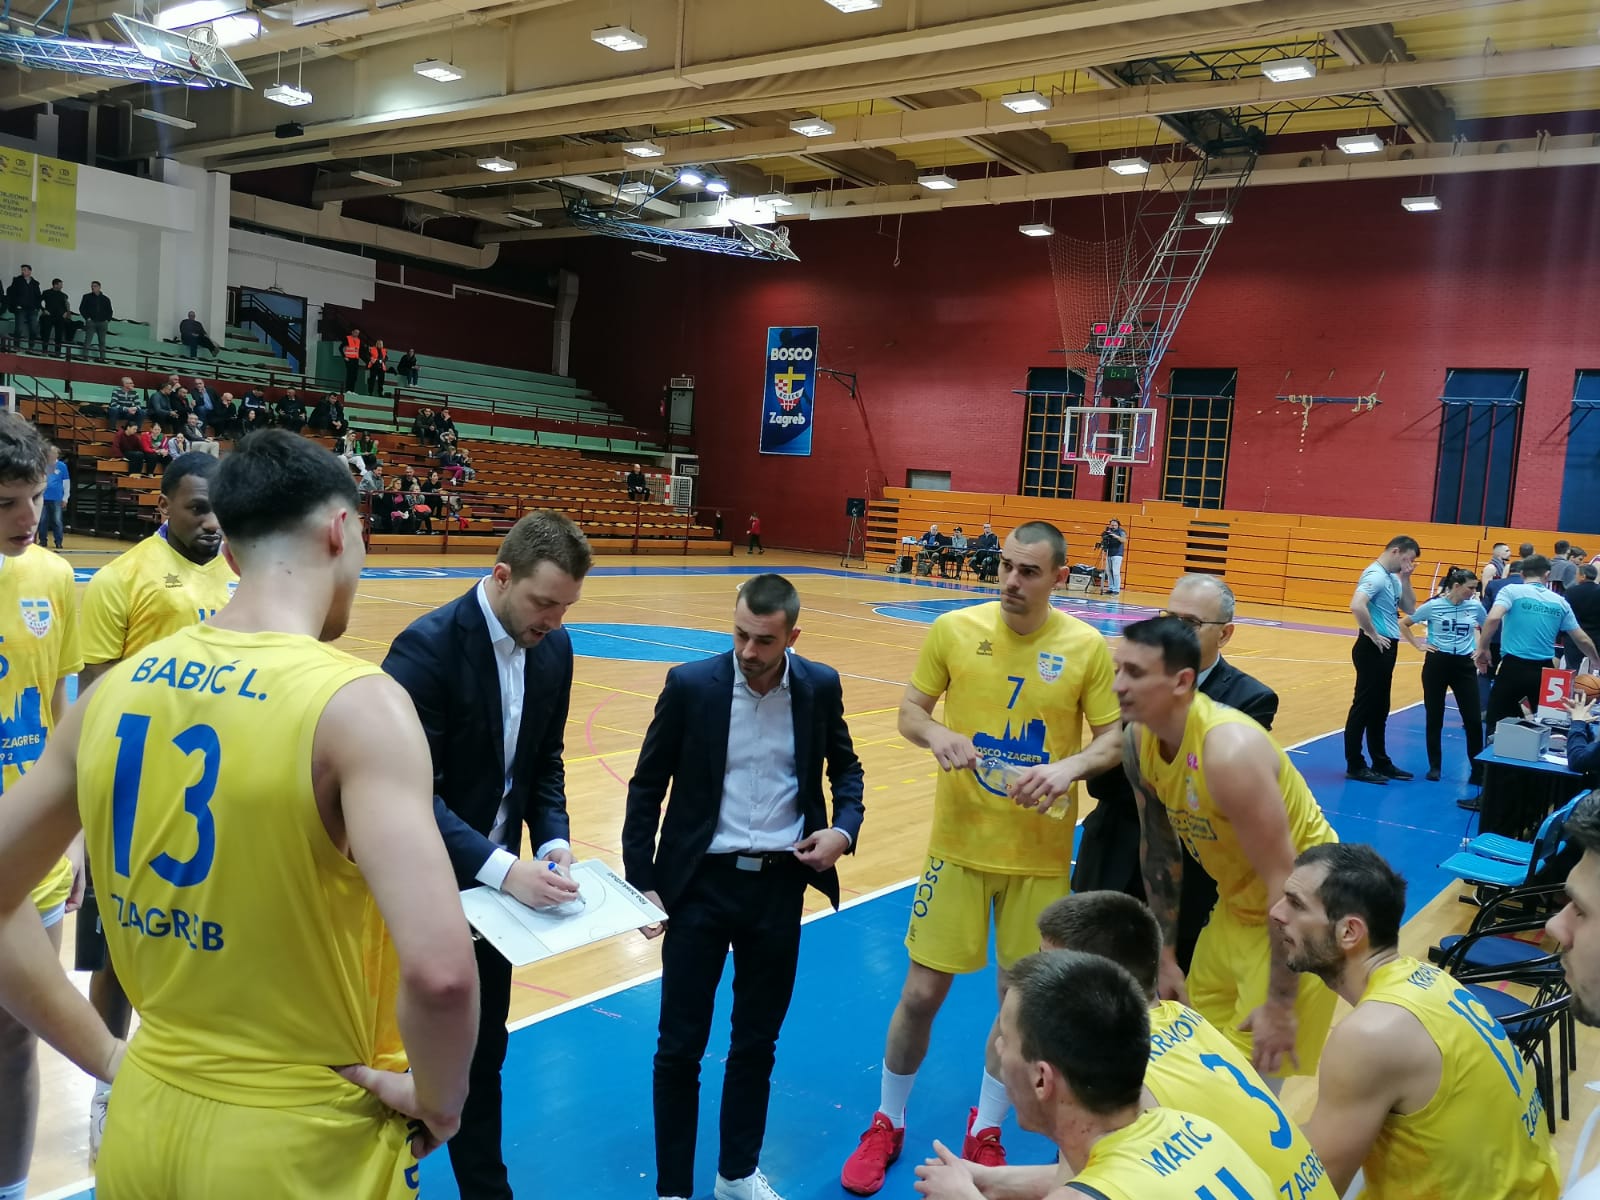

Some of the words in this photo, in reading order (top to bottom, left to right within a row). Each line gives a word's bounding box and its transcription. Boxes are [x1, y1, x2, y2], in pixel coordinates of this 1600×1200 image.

[771, 348, 813, 361] BOSCO
[769, 412, 806, 427] Zagreb
[130, 657, 240, 694] BABIĆ
[238, 668, 267, 701] L.
[1007, 675, 1025, 710] 7
[1546, 677, 1565, 702] 5
[2, 734, 40, 749] ZAGREB
[976, 746, 1001, 757] OSCO
[1007, 751, 1042, 763] ZAGREB
[112, 712, 221, 888] 13
[913, 855, 945, 918] OSCO
[1447, 988, 1524, 1098] 19
[1199, 1053, 1292, 1150] 3
[1141, 1115, 1213, 1177] MATIĆ
